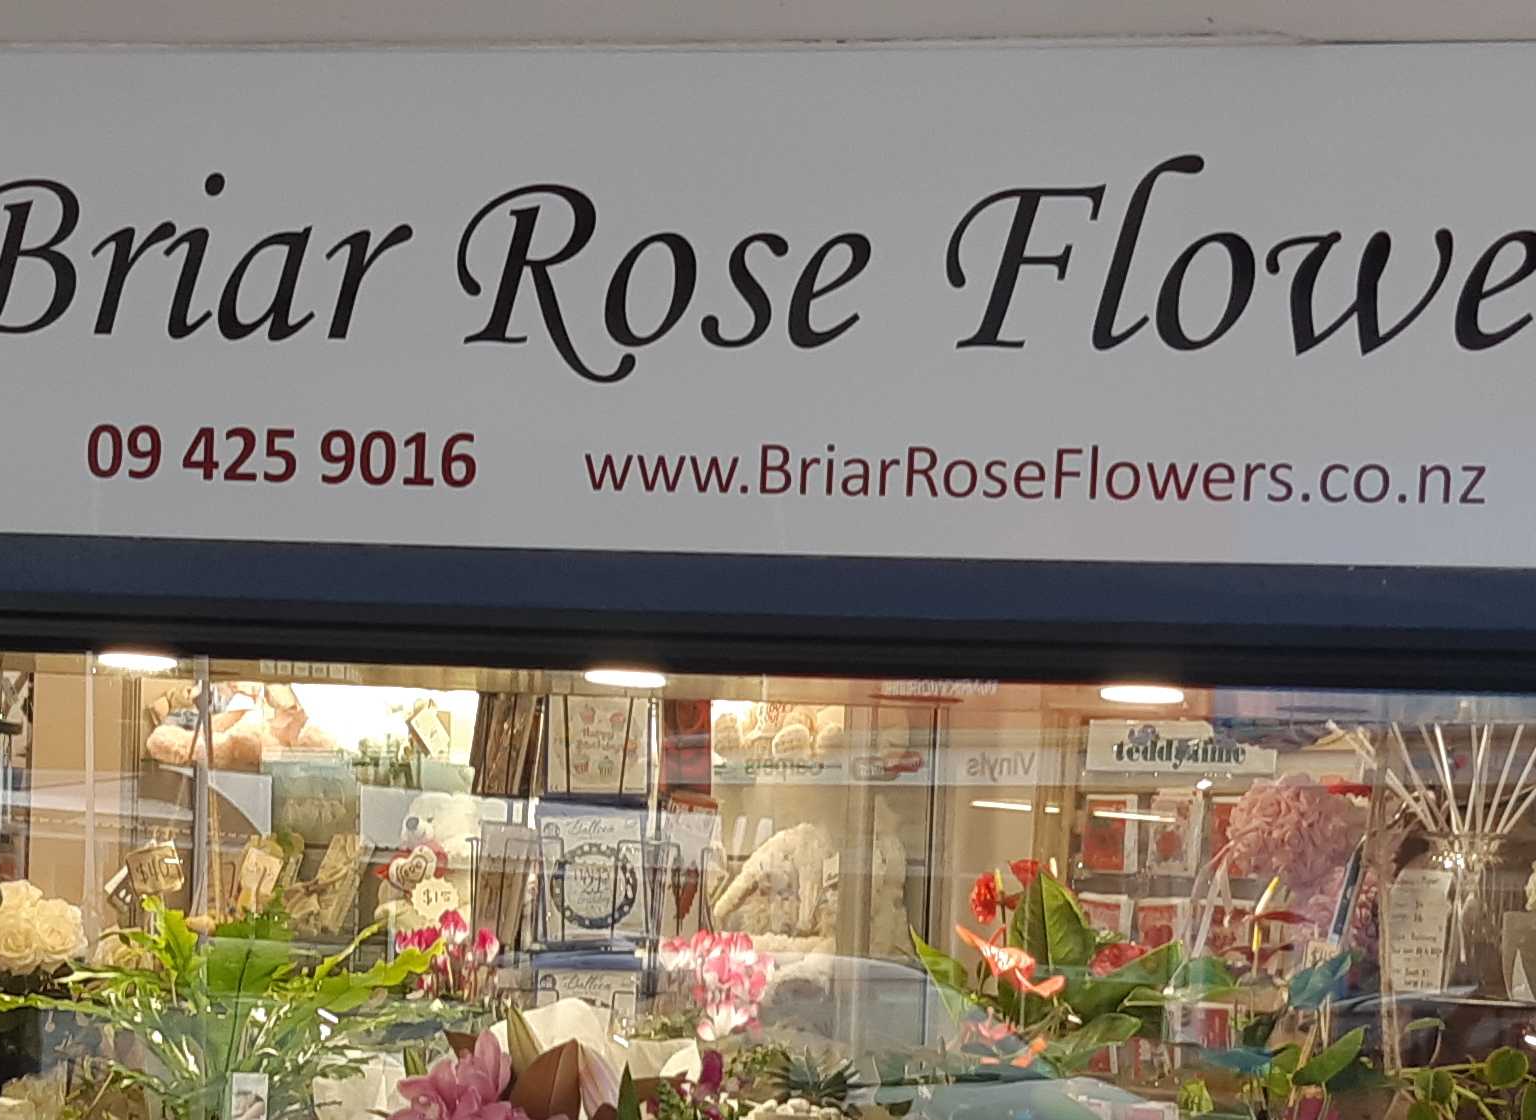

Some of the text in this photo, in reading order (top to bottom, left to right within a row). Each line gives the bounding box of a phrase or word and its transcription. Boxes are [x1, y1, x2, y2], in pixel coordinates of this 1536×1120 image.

[457, 183, 872, 383] Rose
[86, 424, 478, 489] 09 425 9016
[585, 443, 1487, 505] www.BriarRoseFlowers.co.nz
